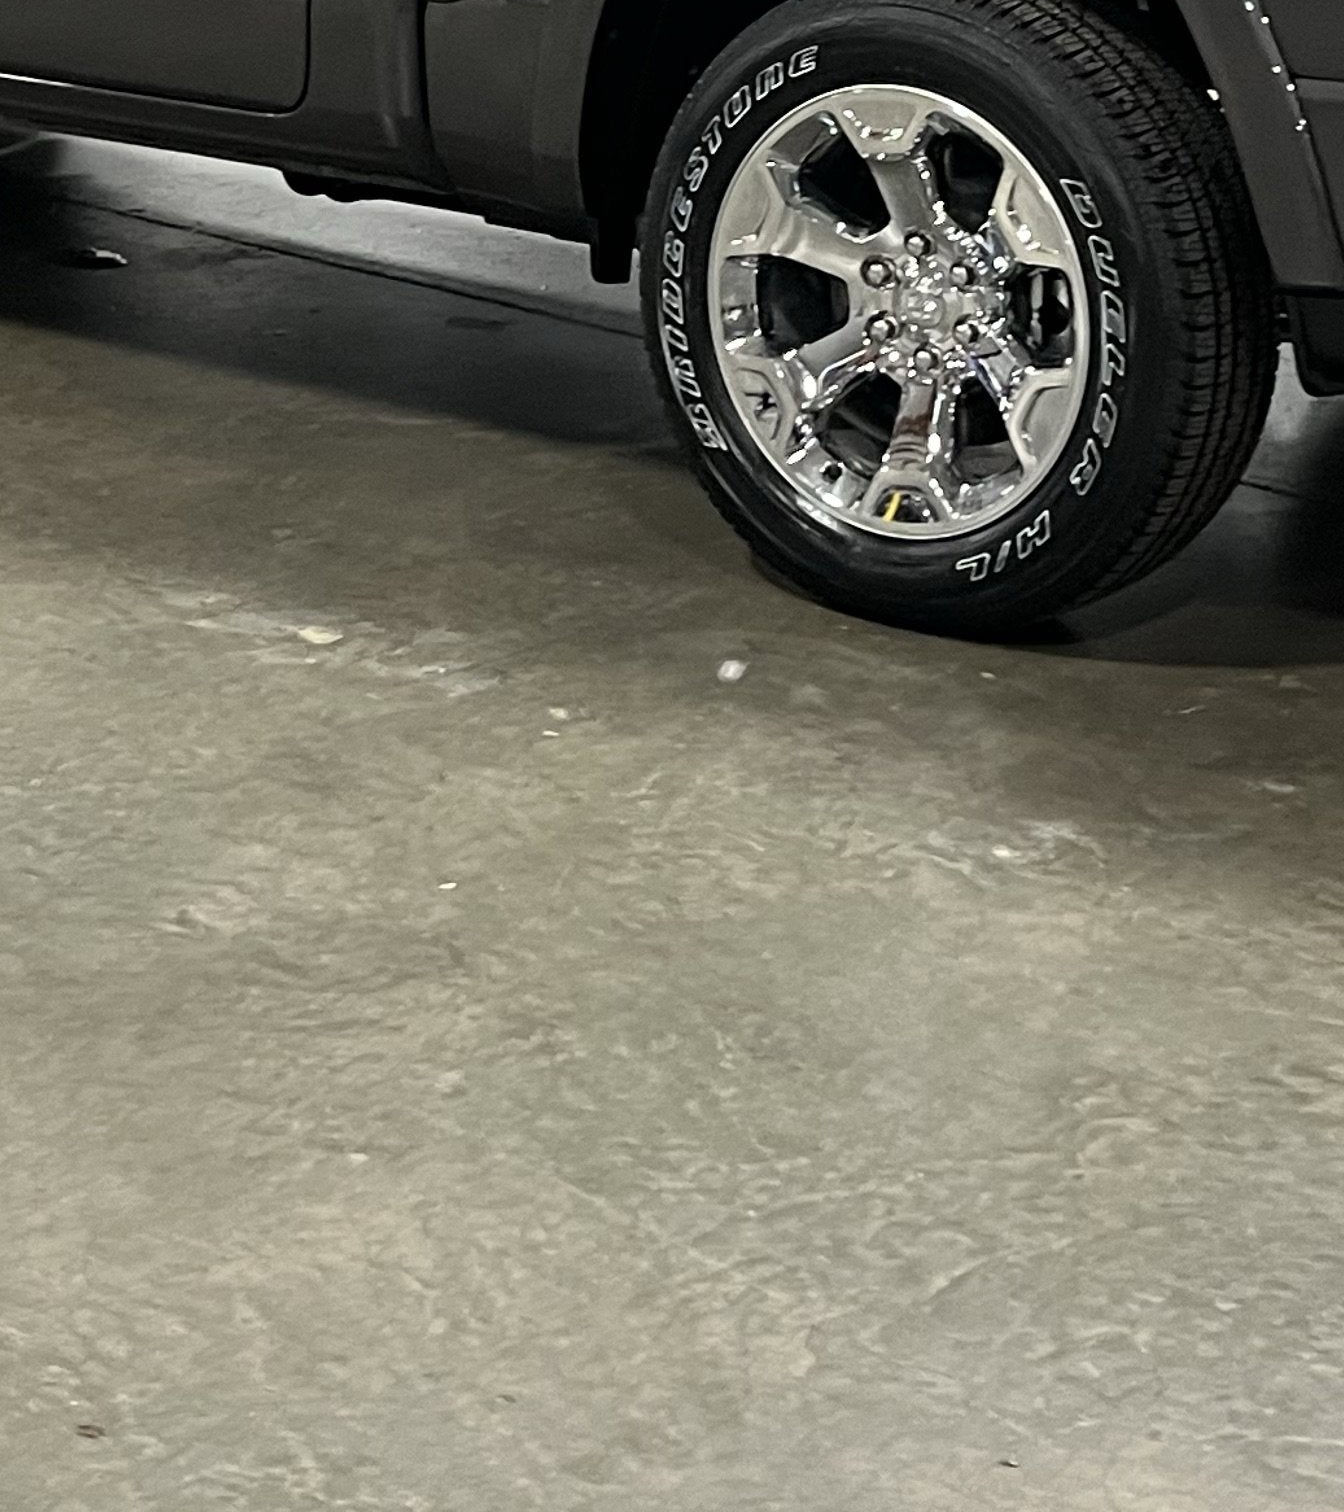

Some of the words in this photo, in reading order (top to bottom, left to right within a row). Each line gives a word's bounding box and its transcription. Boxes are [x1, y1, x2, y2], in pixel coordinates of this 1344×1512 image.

[660, 44, 819, 454] BRIDGESTONE
[1060, 177, 1126, 496] DUELER
[956, 509, 1051, 582] H/L
